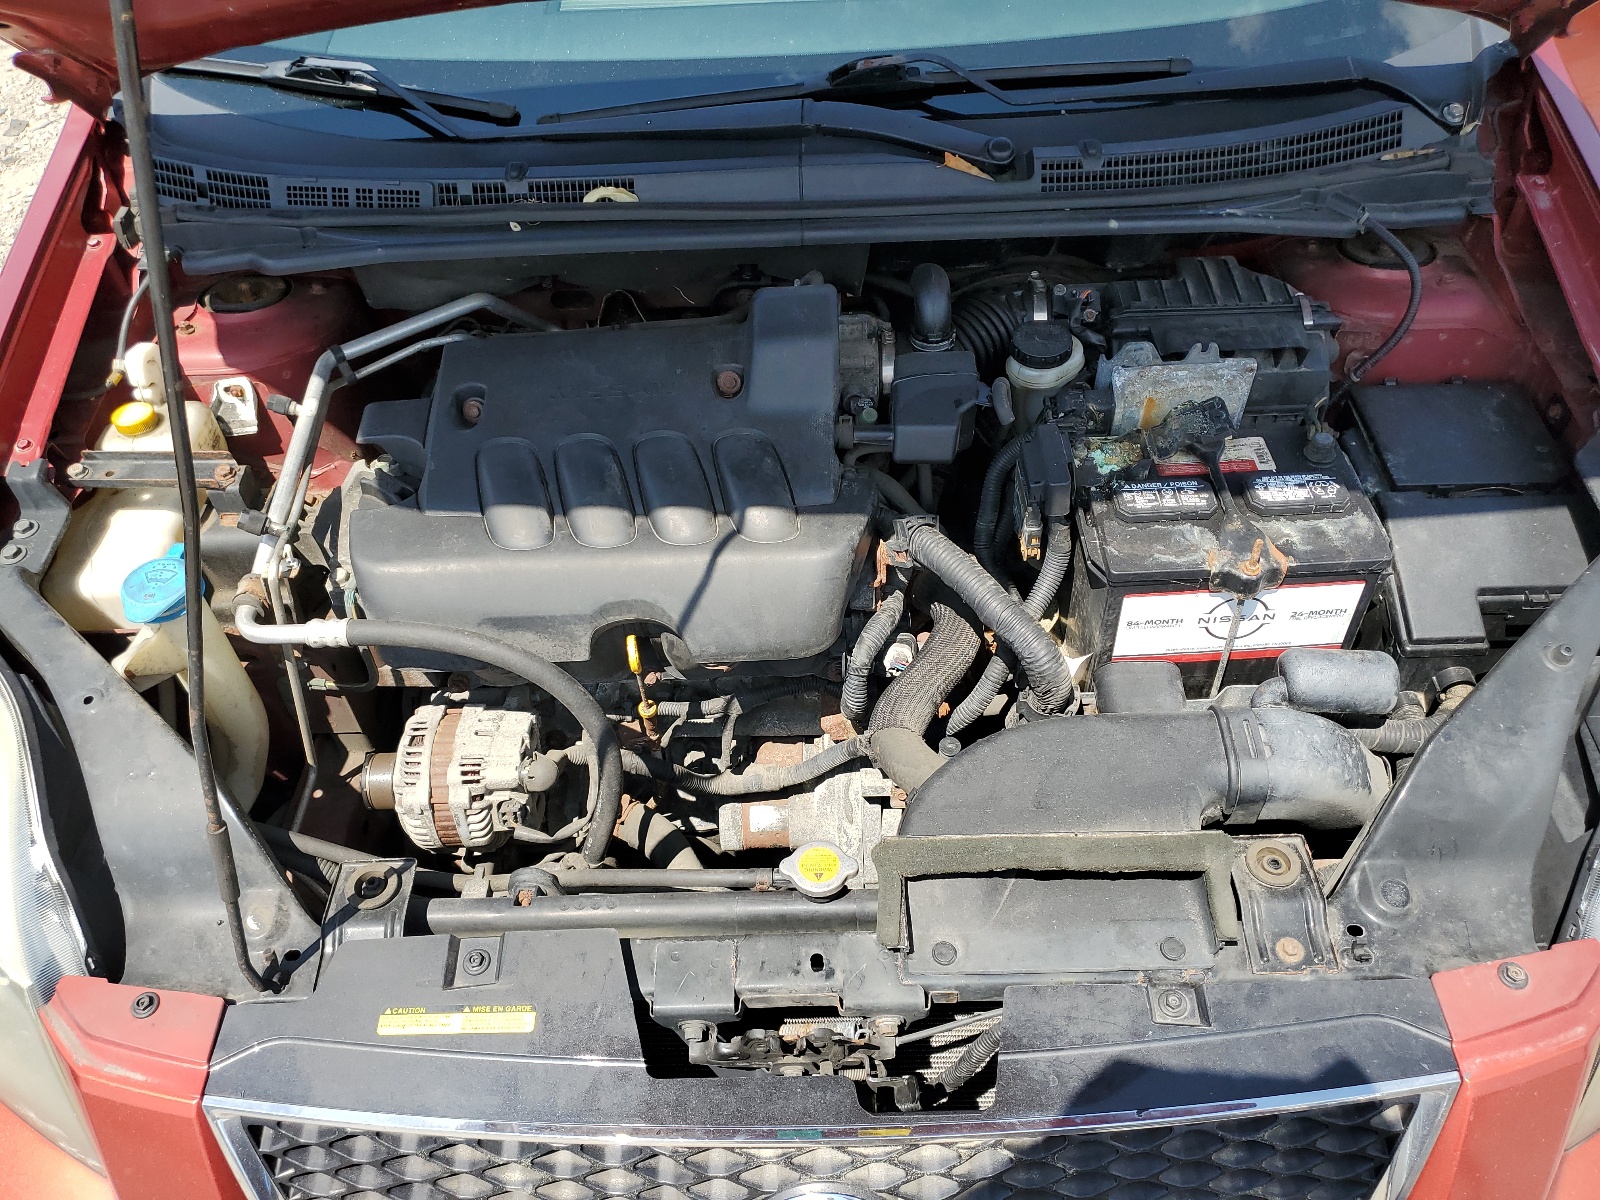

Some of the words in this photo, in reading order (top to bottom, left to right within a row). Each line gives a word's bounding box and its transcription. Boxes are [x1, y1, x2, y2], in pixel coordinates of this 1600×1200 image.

[1290, 608, 1348, 618] 24-MONTH
[1126, 618, 1184, 627] 84-MONTH
[392, 1007, 426, 1015] CAUTION
[472, 1005, 491, 1013] MISE
